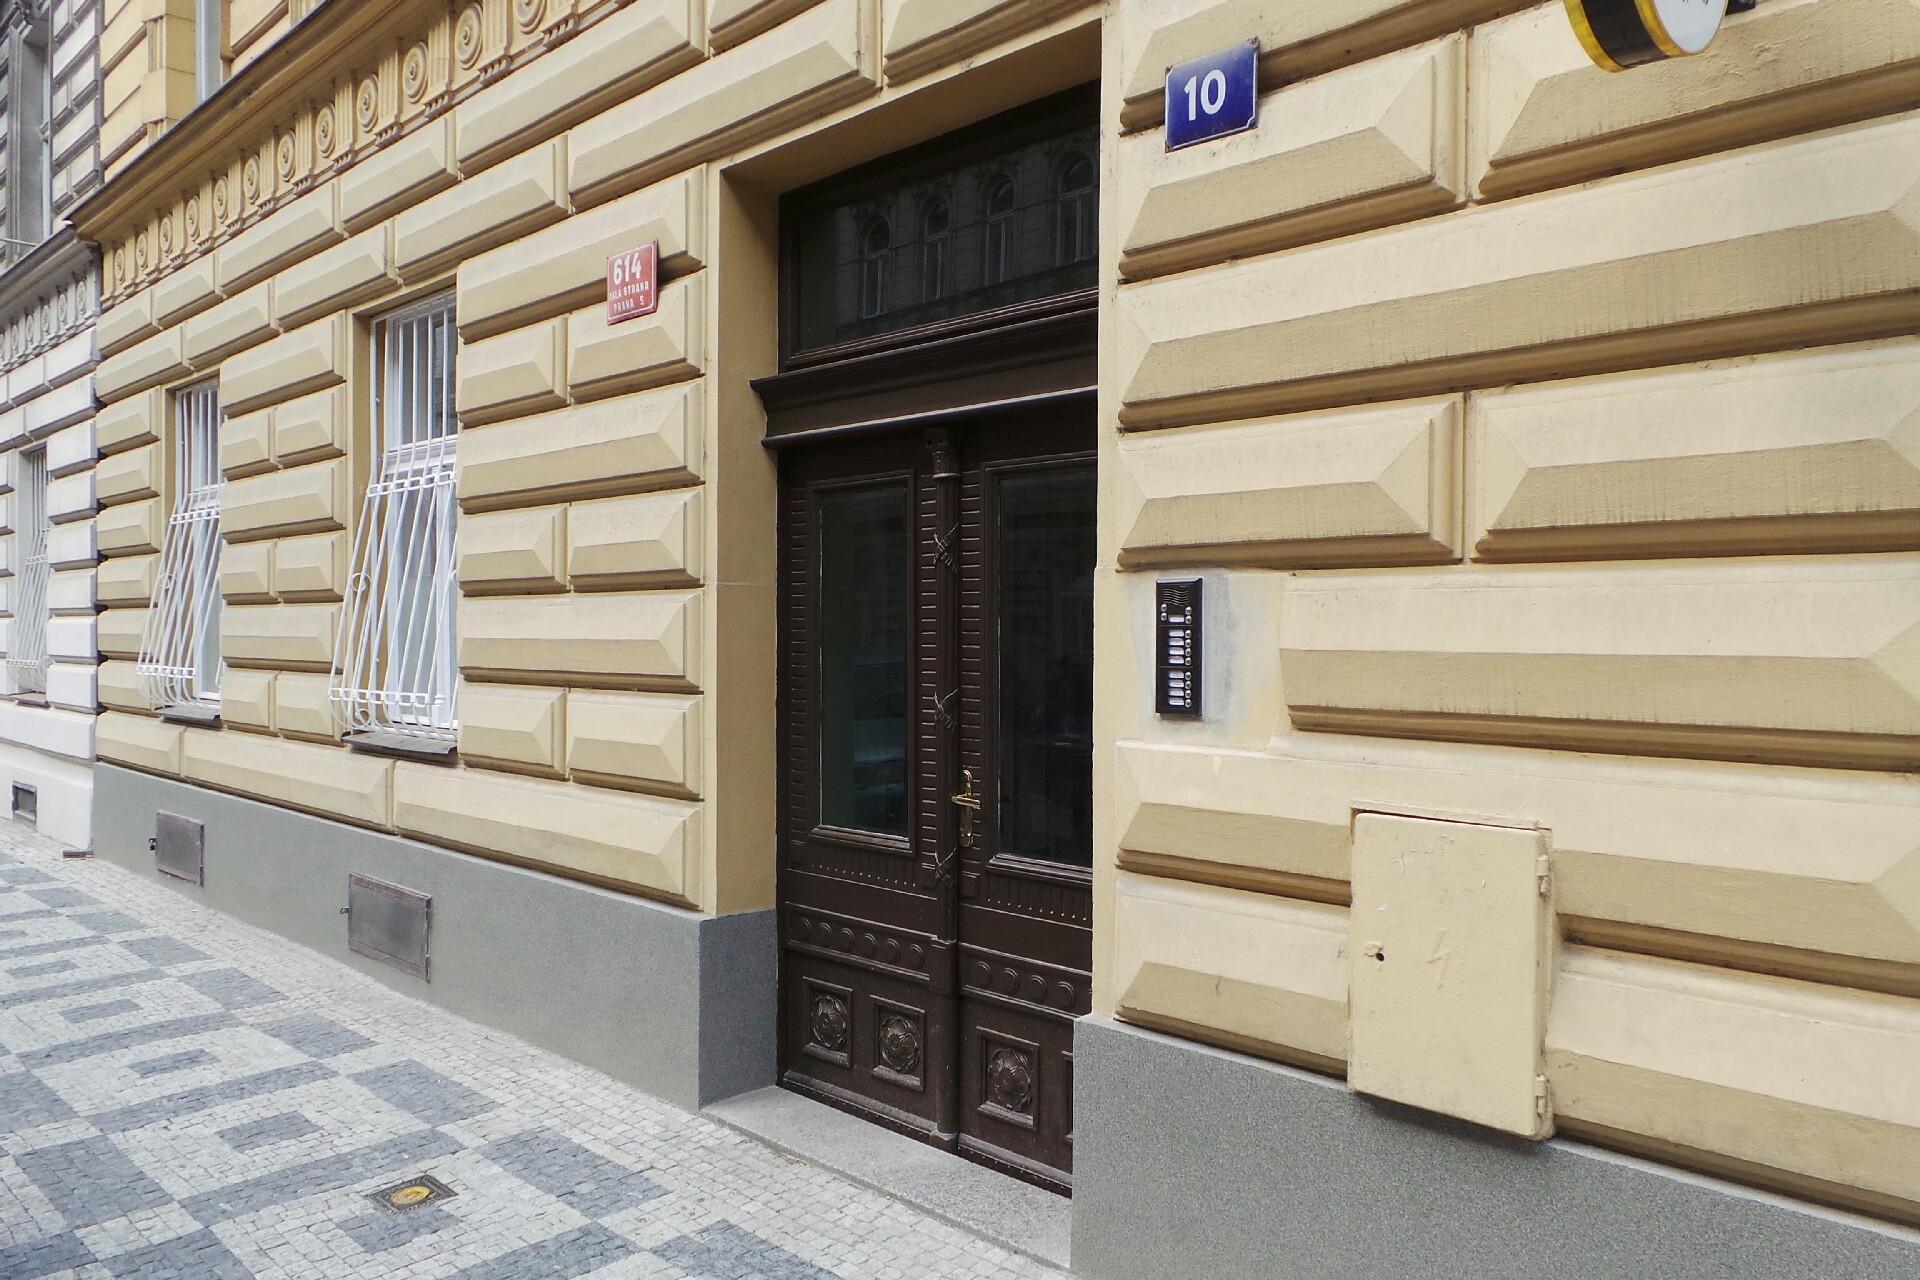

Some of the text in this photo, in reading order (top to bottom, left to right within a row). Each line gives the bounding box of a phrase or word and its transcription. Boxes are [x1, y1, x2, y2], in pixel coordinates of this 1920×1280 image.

[1184, 69, 1226, 121] 10
[613, 252, 642, 285] 614
[623, 281, 649, 296] STRANA
[613, 295, 645, 313] PRAHA 5
